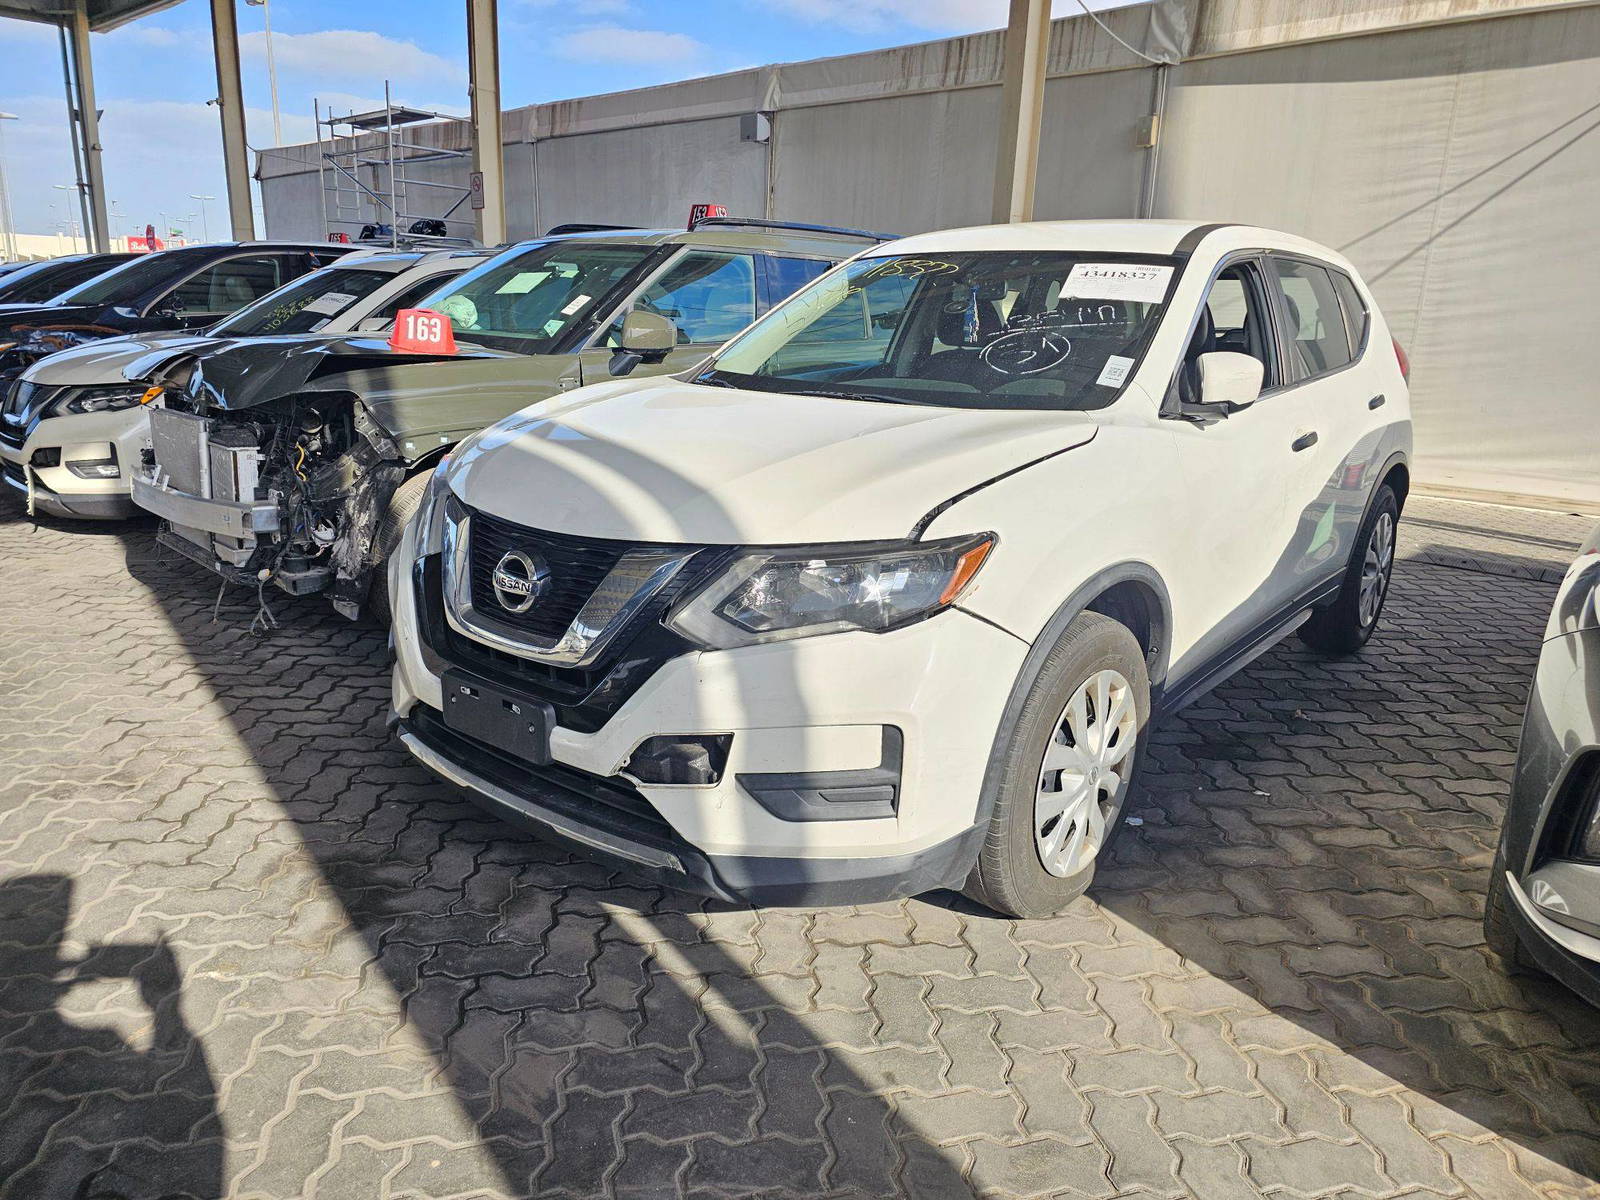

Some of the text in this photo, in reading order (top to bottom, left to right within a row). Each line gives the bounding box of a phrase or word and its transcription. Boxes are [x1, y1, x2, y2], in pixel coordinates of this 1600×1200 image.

[1080, 269, 1157, 280] 43418327
[406, 315, 441, 343] 163
[495, 576, 531, 592] NISSAN
